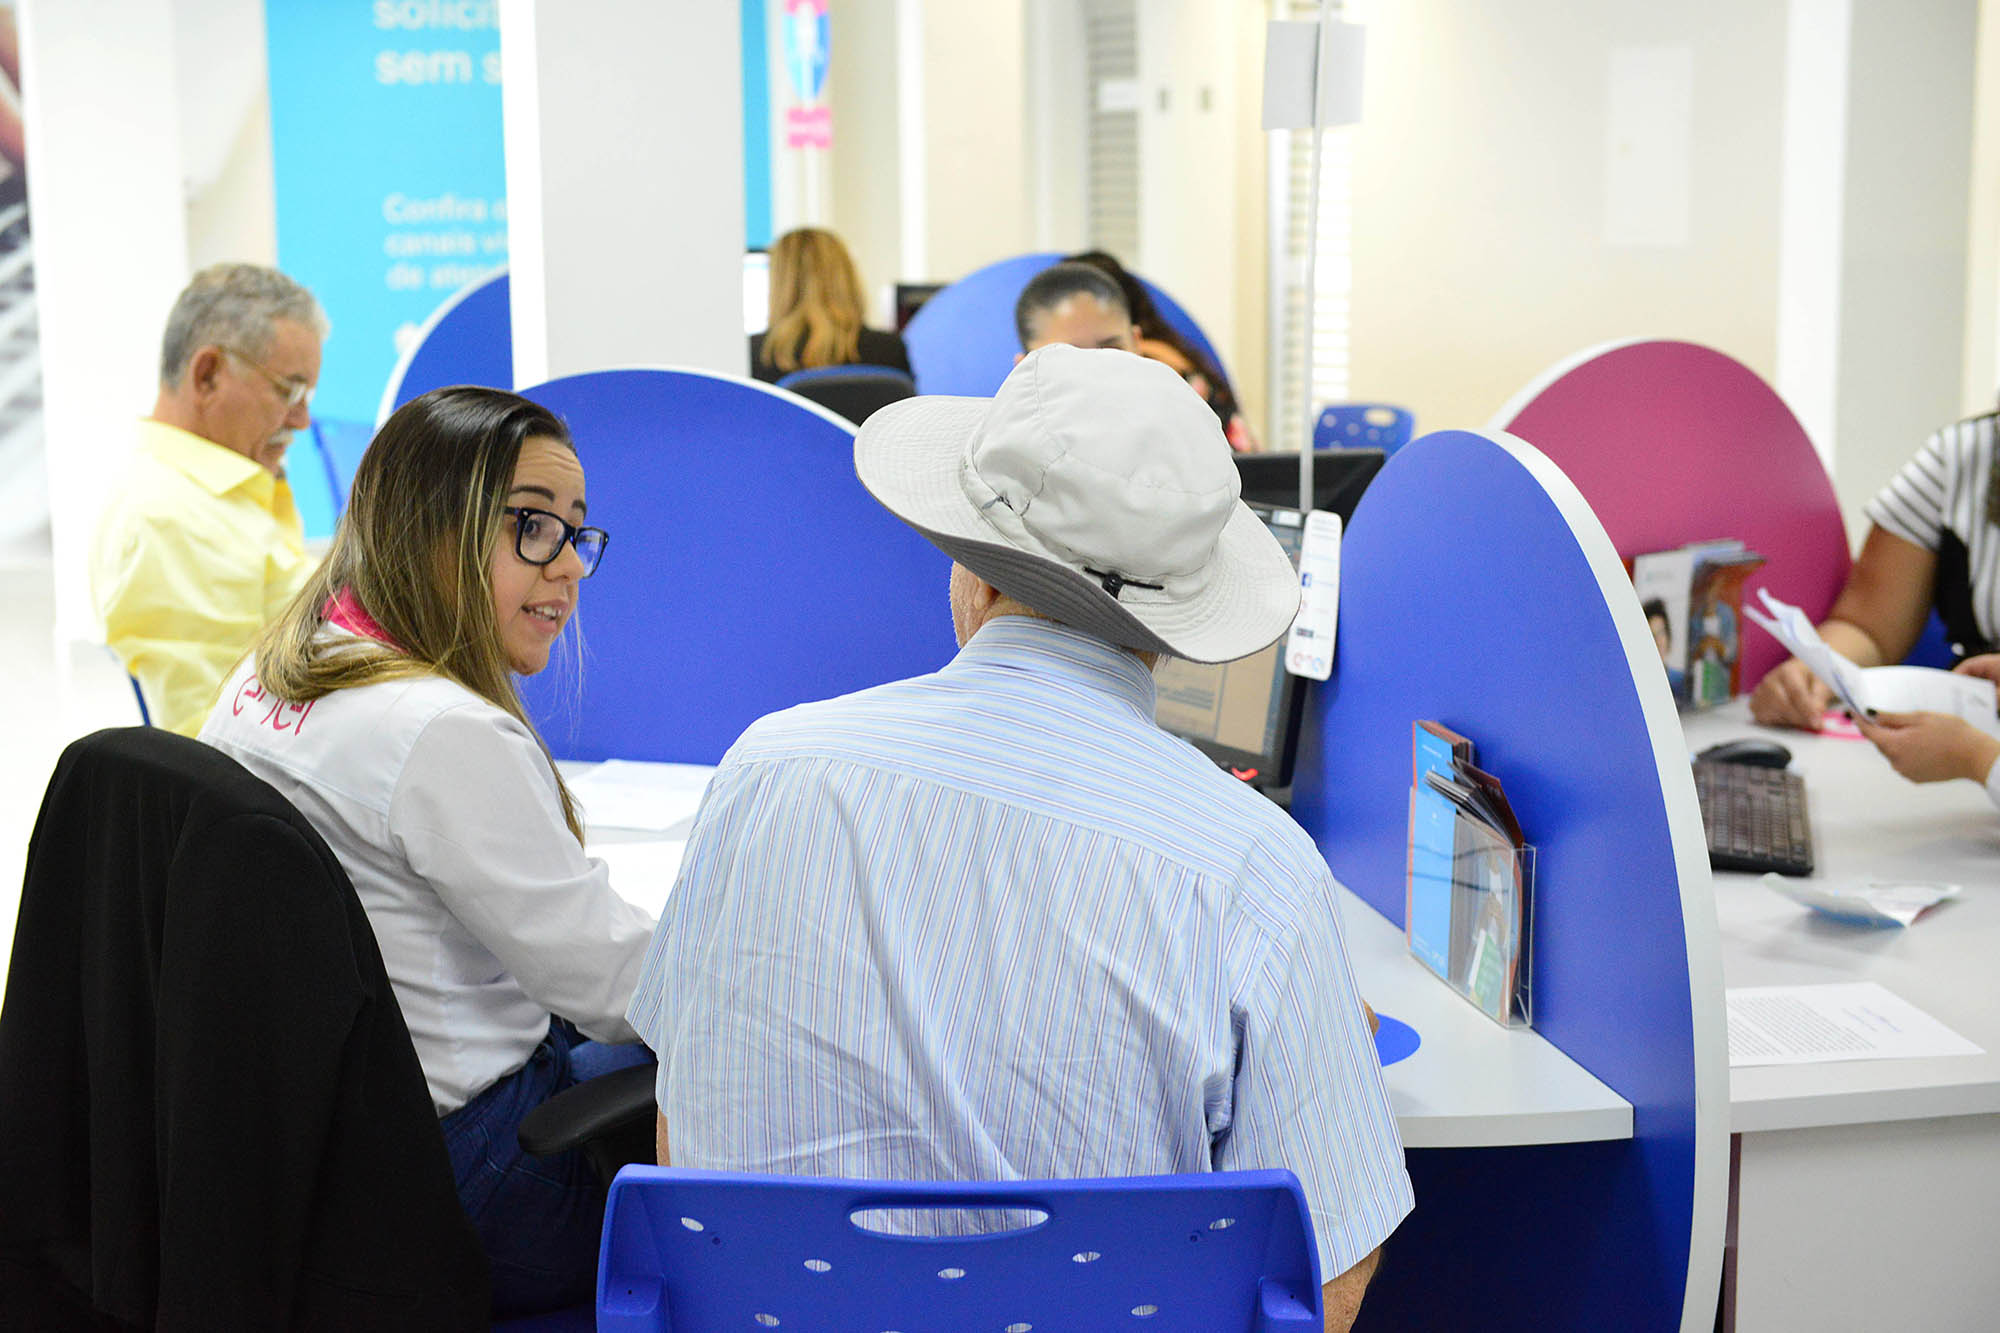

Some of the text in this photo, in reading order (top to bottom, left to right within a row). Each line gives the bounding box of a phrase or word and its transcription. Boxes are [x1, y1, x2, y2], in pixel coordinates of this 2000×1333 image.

[376, 51, 472, 84] sem
[383, 193, 487, 222] Confira
[387, 262, 424, 289] de
